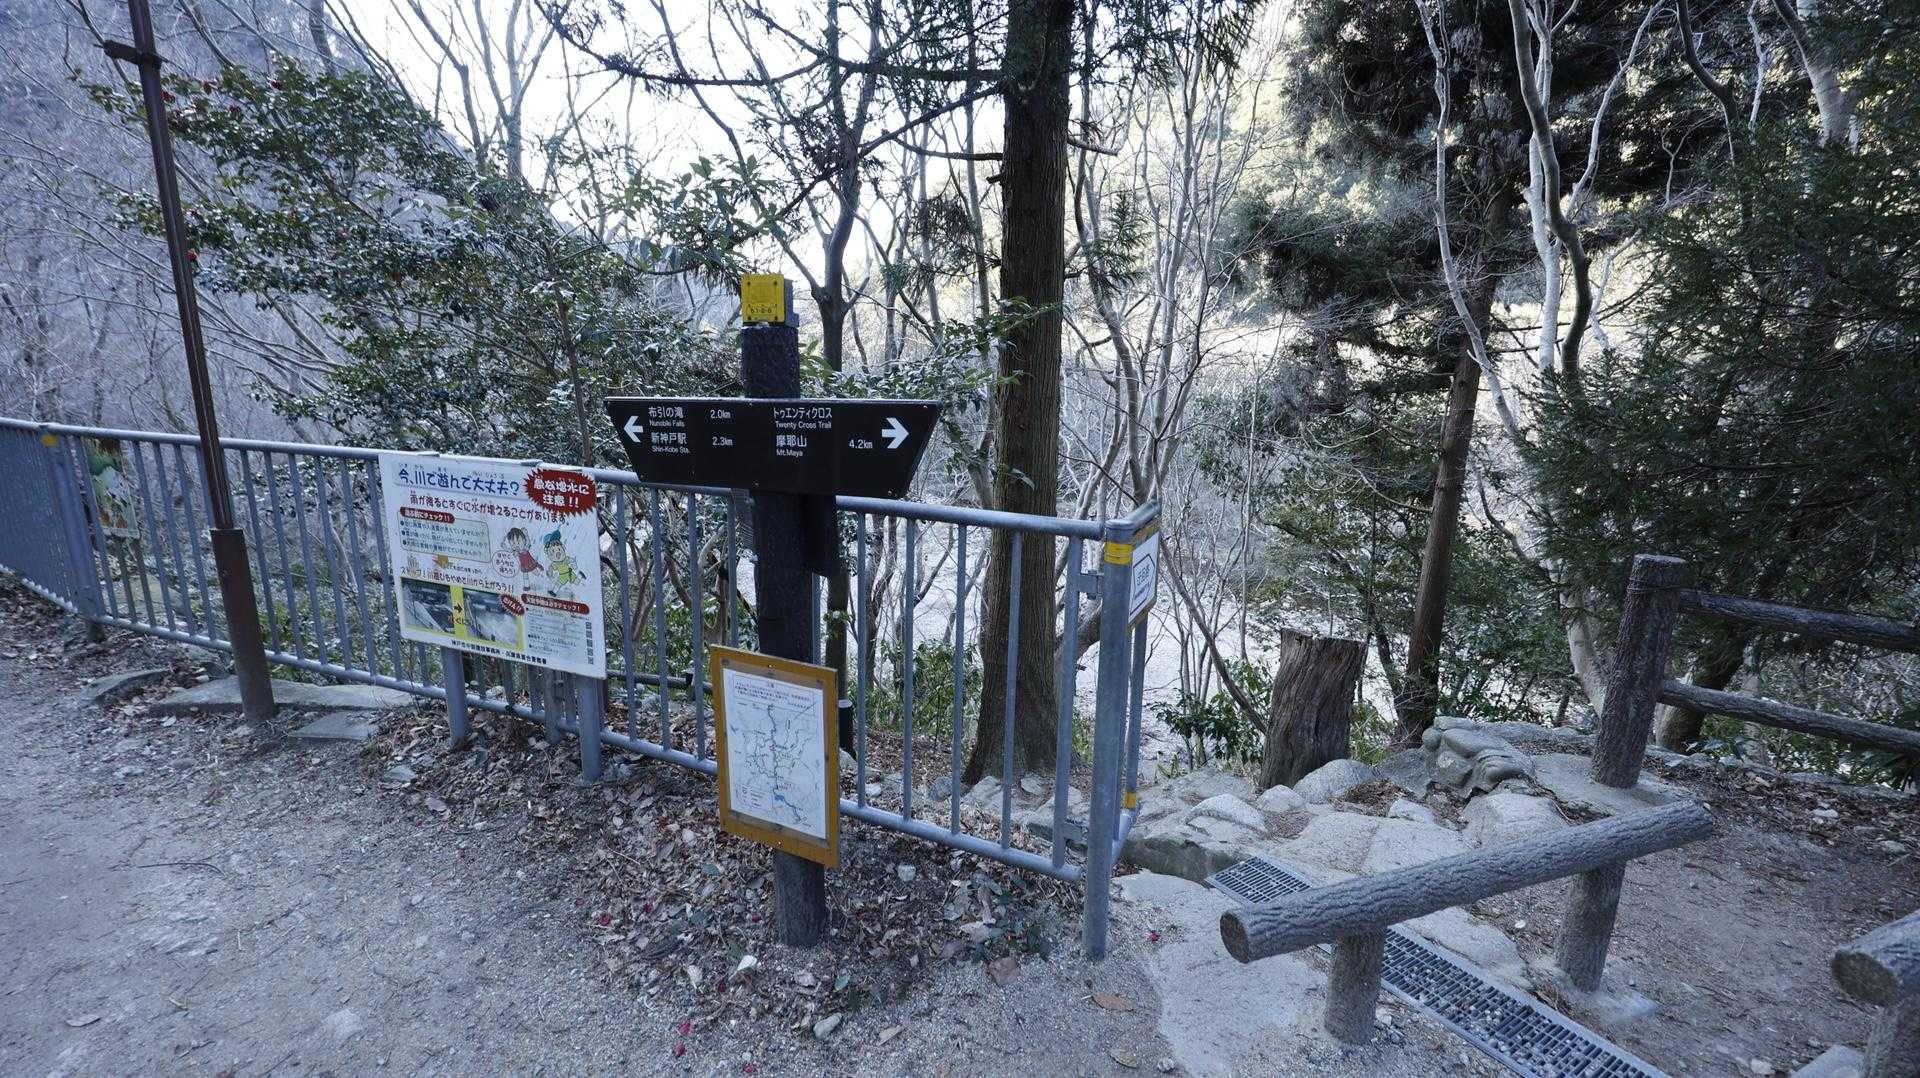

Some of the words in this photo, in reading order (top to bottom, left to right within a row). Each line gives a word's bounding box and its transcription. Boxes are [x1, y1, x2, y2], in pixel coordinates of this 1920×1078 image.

[648, 406, 684, 419] 布引の滝
[710, 409, 731, 419] 2.0km
[773, 407, 833, 419] トゥエンティクロス
[649, 419, 672, 427] Nunobiki
[775, 420, 797, 430] Twenty
[798, 421, 817, 429] Cross
[818, 421, 832, 429] Trail
[651, 432, 687, 444] 新神戸駅
[712, 436, 733, 446] 2.3km
[775, 434, 807, 448] 摩耶山
[848, 439, 873, 449] 4.2km
[652, 445, 679, 454] Shin-Kobe
